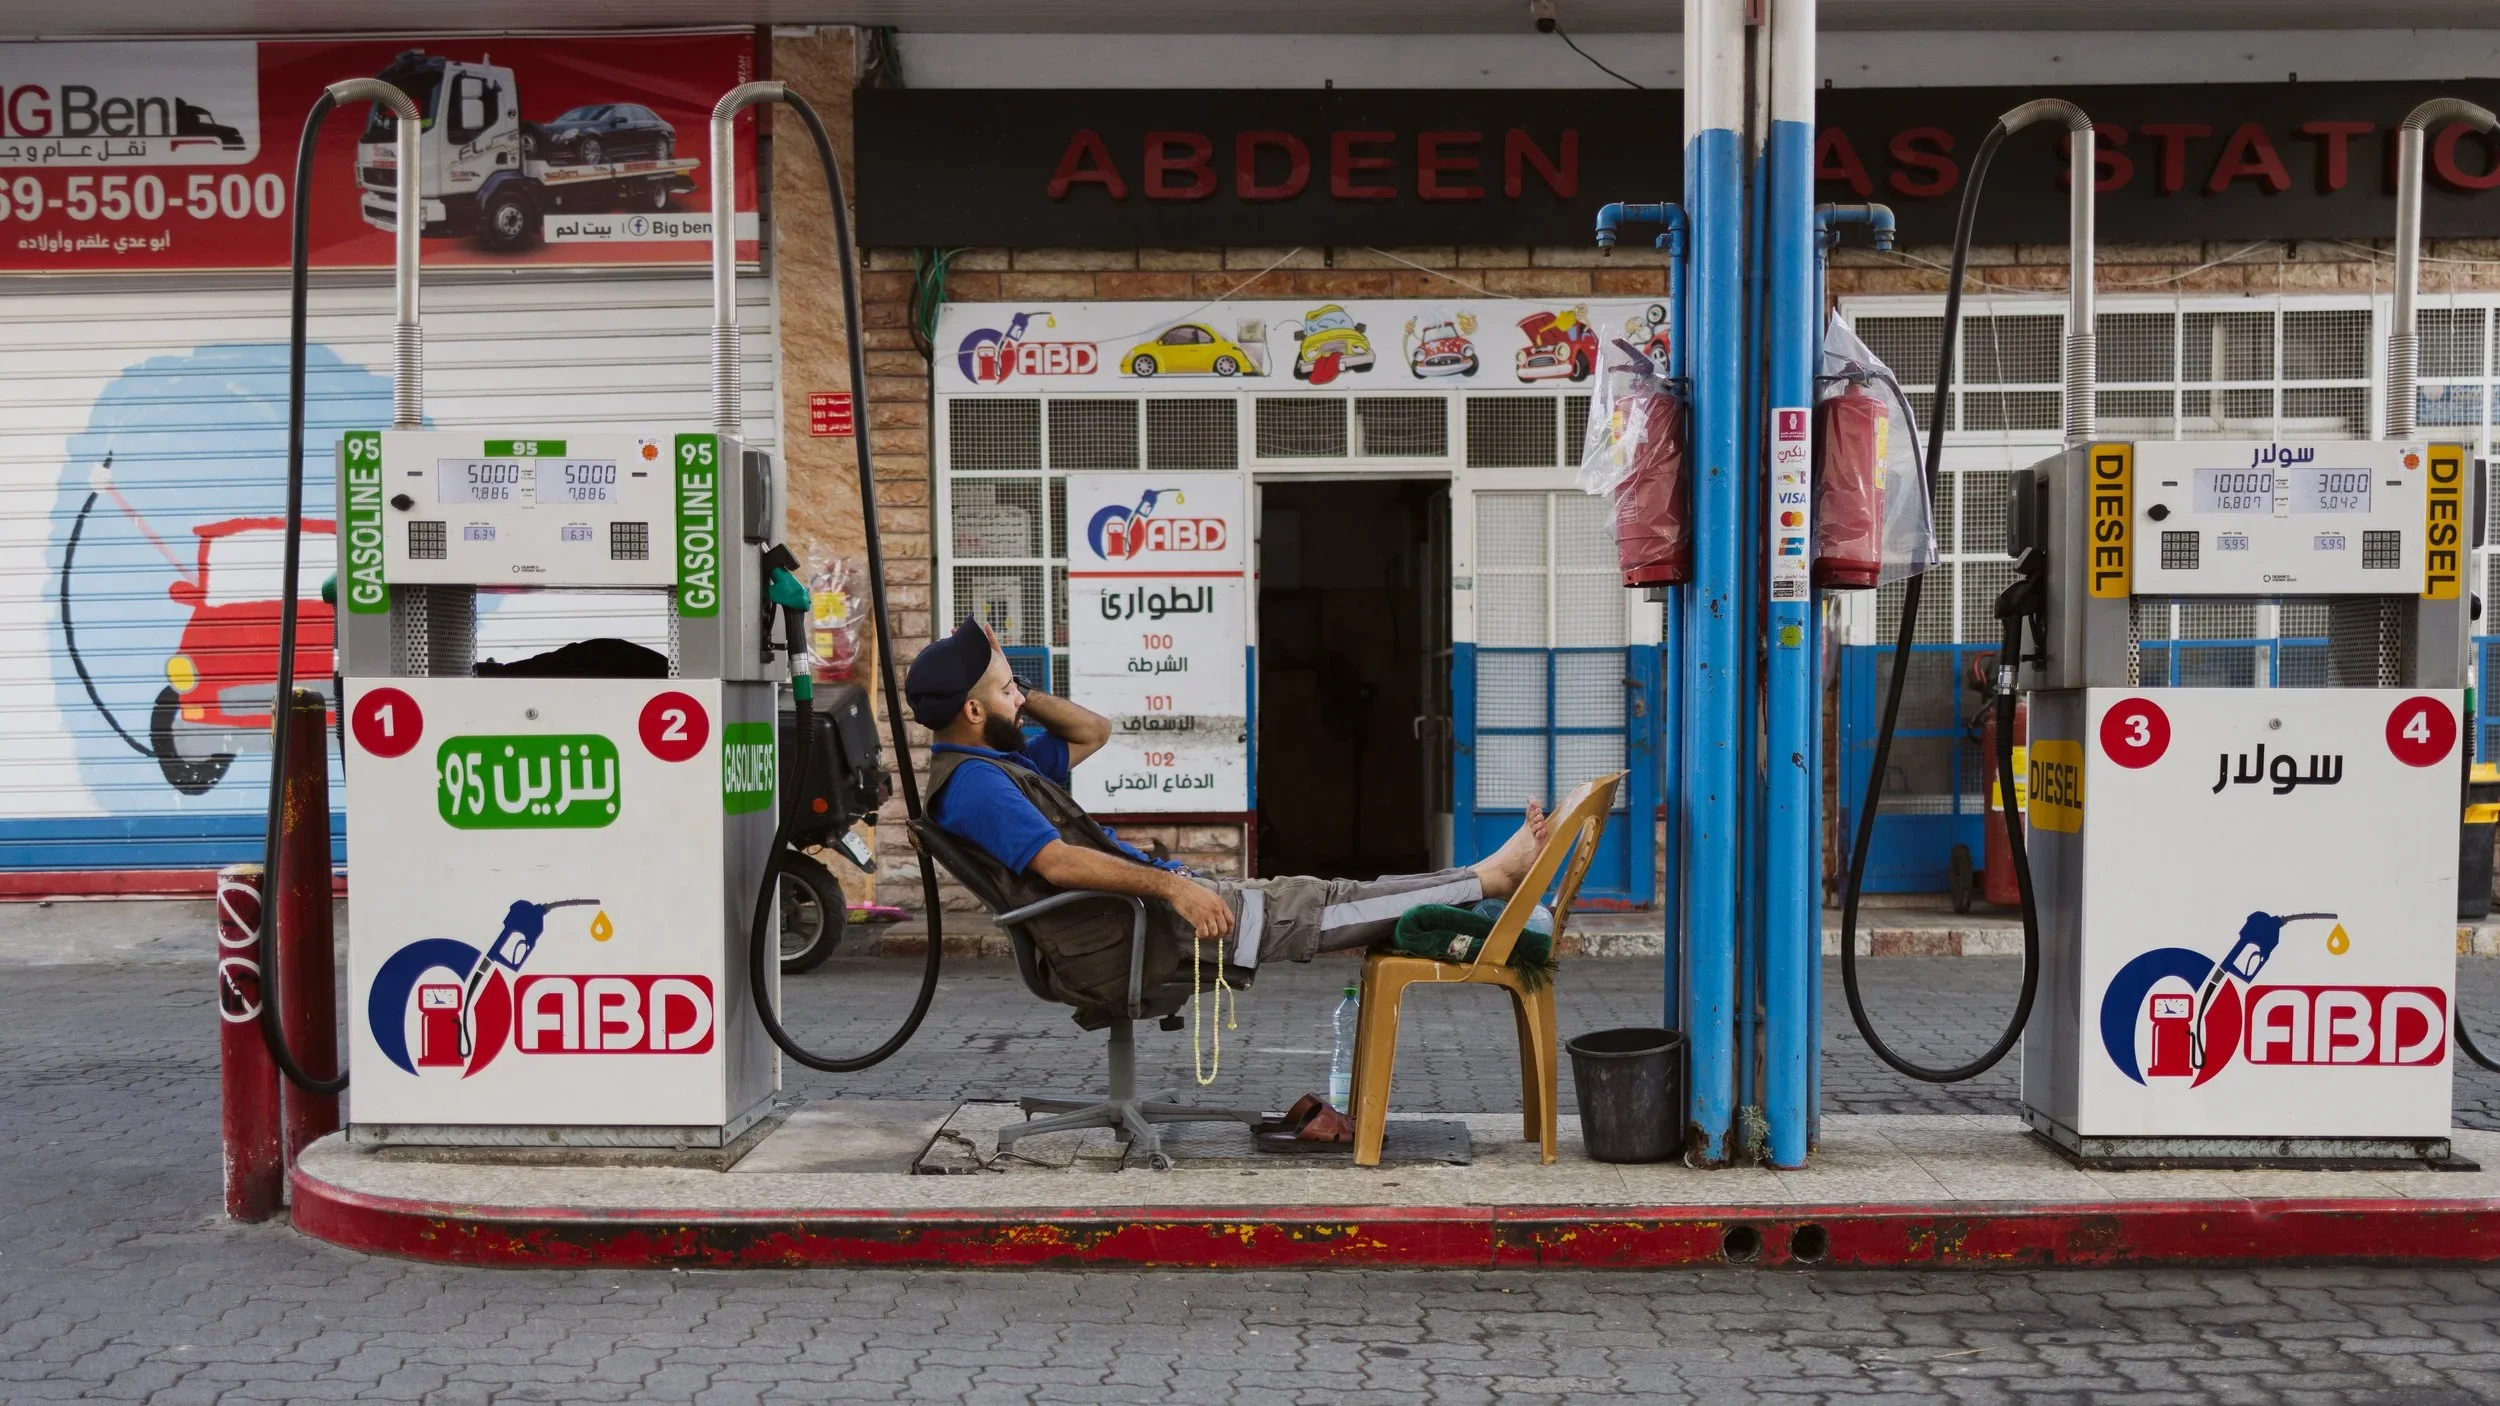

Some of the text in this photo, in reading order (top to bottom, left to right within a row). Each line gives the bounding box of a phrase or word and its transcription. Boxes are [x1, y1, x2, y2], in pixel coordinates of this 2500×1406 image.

[61, 85, 170, 137] Ben
[43, 140, 92, 163] عام
[98, 140, 146, 161] نقل
[1047, 120, 2500, 200] ABDEEN AS STATO
[18, 229, 171, 254] أبو عدي علقم وأولاده
[556, 221, 612, 239] بيت لحم
[653, 221, 679, 237] Big
[683, 220, 712, 234] ben
[1018, 342, 1097, 375] ABD
[348, 439, 380, 460] 95
[512, 441, 538, 455] 95
[681, 443, 713, 465] 95
[2251, 443, 2315, 468] سولار
[1778, 492, 1806, 504] VISA
[349, 467, 383, 604] GASOLINE
[1148, 519, 1226, 550] ABD
[2095, 455, 2124, 592] DIESEL
[2428, 458, 2459, 595] DIESEL
[682, 474, 716, 609] GASOLINE
[1100, 586, 1214, 620] الطوارئ
[1142, 635, 1173, 650] 100
[1128, 657, 1188, 676] الشرطة
[1145, 696, 1172, 711] 101
[373, 704, 395, 737] 1
[660, 709, 688, 742] 2
[2124, 715, 2151, 747] 3
[2402, 711, 2431, 744] 4
[724, 743, 764, 793] GASOLINE
[1144, 752, 1175, 766] 102
[2211, 743, 2344, 795] سولار
[445, 744, 615, 816] بنزين 95
[1105, 773, 1214, 797] الدفاع المدني
[2030, 761, 2083, 810] DIESEL
[520, 977, 714, 1051] ABD
[2250, 989, 2446, 1064] ABD
